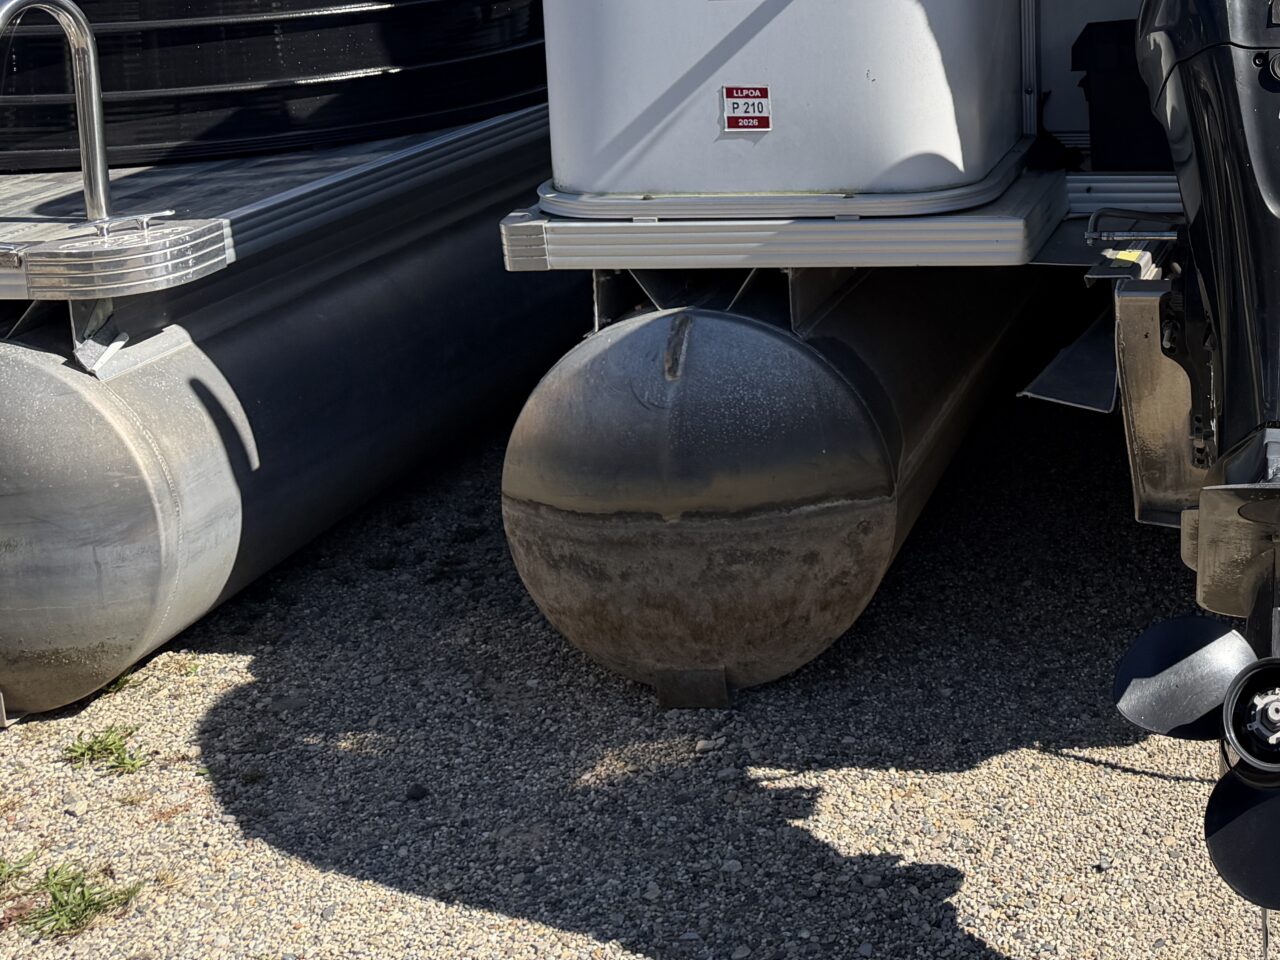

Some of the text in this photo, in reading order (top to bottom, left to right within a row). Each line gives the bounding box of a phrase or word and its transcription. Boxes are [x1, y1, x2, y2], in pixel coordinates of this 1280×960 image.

[733, 89, 761, 97] LLPOA
[732, 102, 764, 114] P 210
[738, 118, 759, 127] 2026
